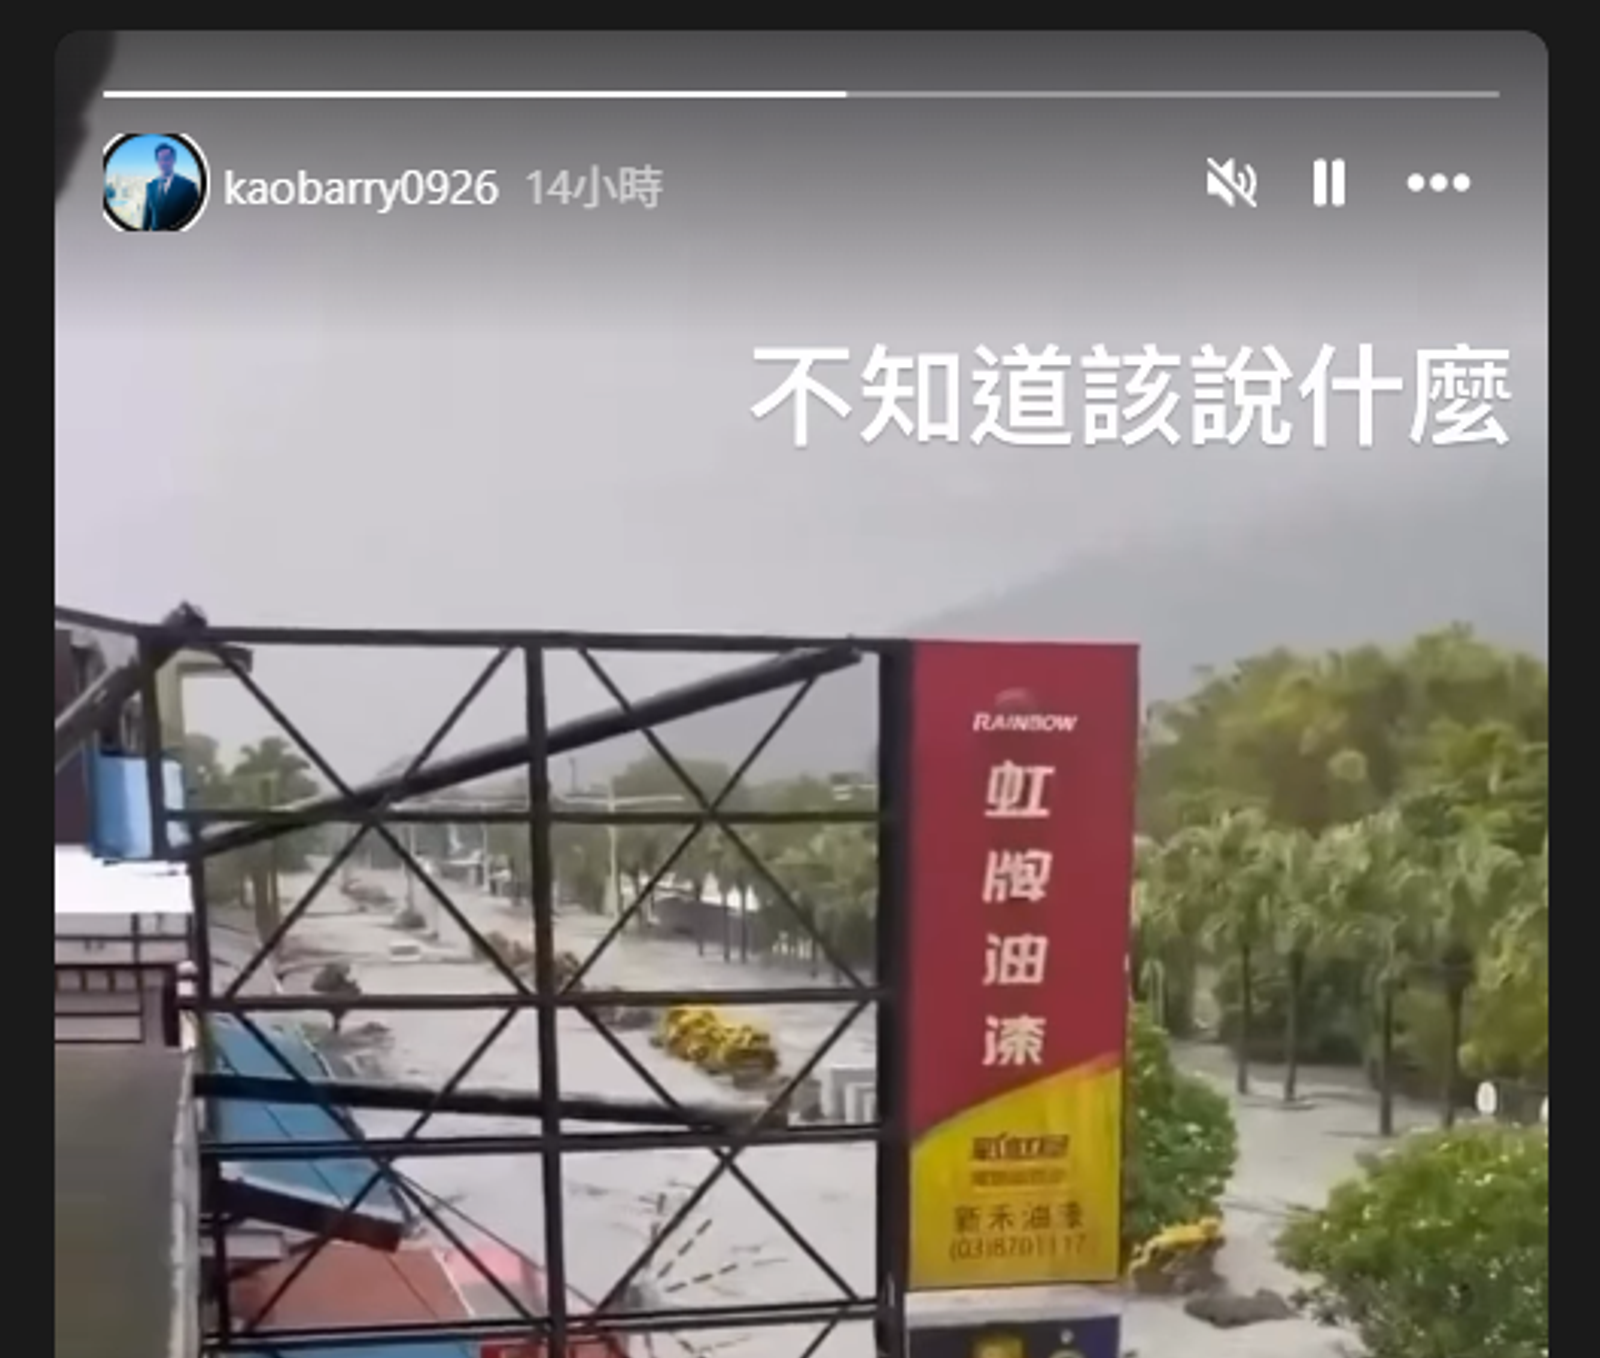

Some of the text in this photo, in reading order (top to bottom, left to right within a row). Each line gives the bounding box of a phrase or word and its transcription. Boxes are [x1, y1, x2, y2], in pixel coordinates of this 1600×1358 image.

[972, 712, 1078, 732] RAINBOW
[982, 760, 1055, 1066] 虹牌油漆
